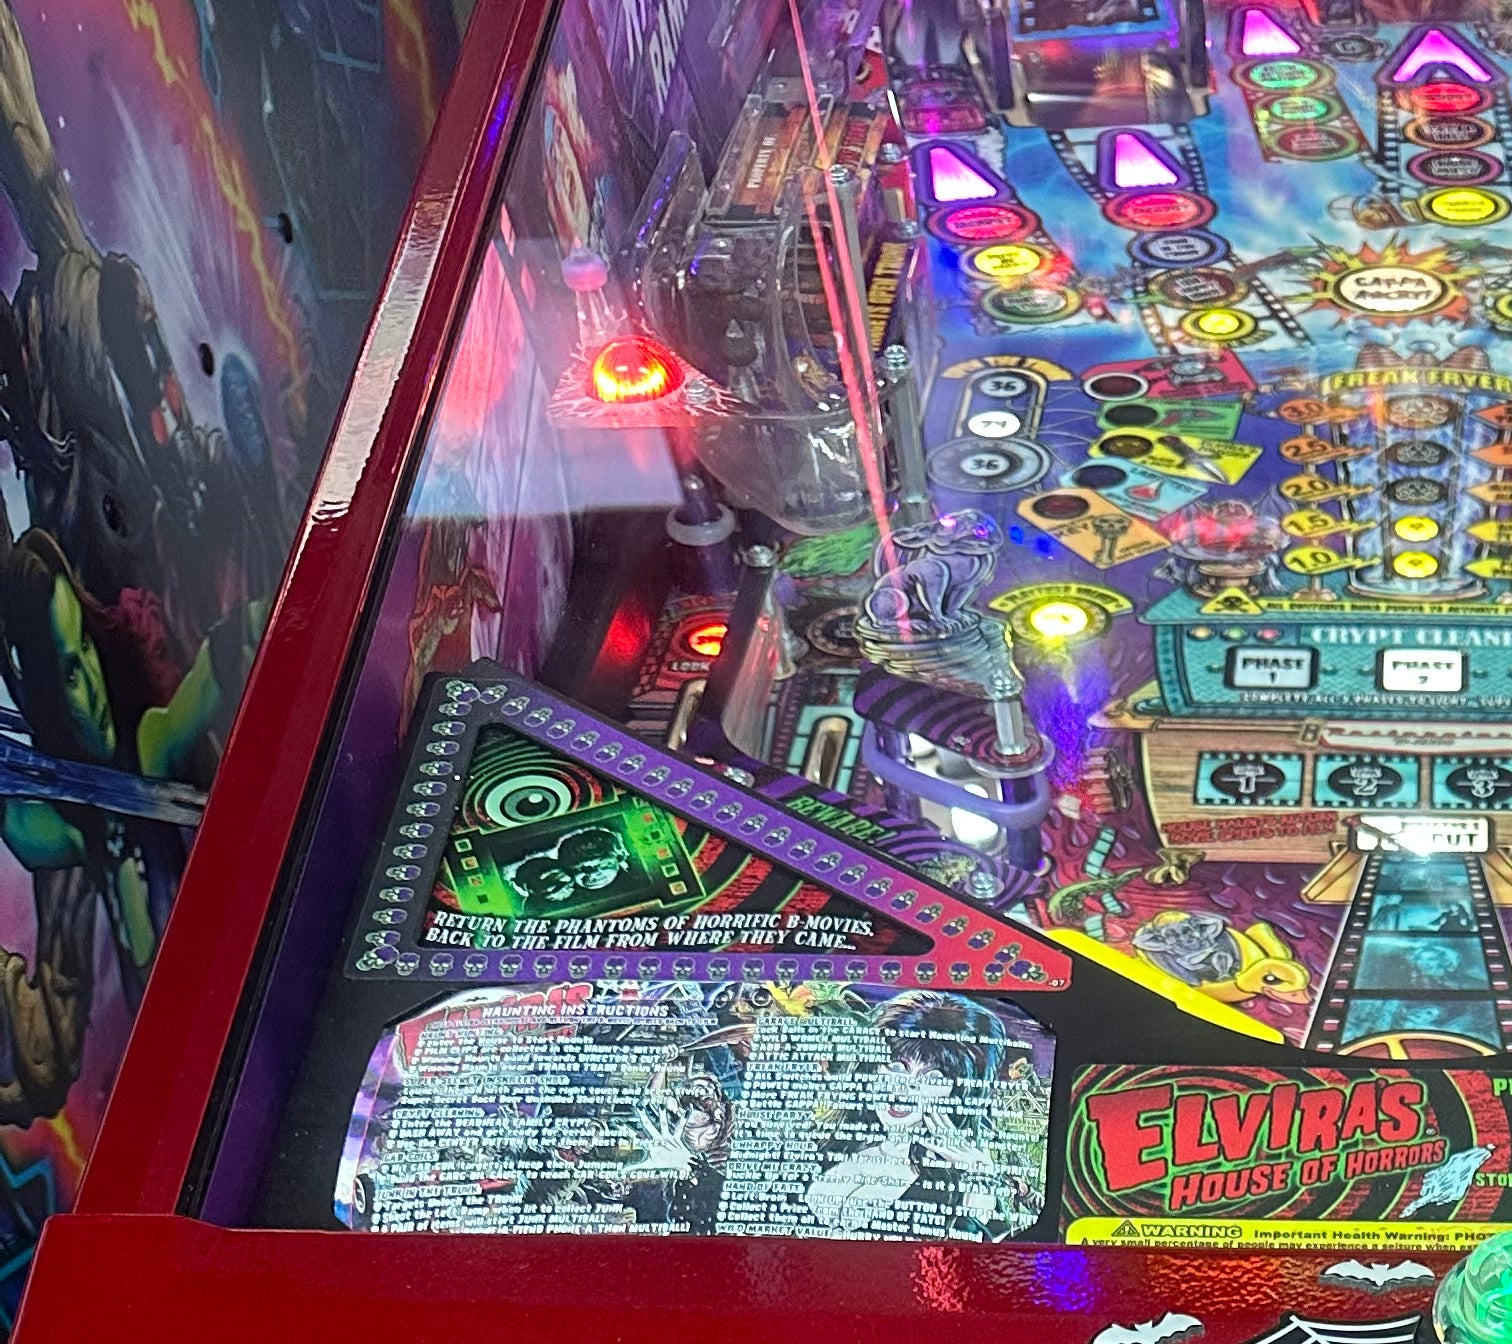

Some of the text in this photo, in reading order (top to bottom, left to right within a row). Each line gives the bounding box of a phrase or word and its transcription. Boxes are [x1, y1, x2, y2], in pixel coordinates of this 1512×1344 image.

[1331, 369, 1418, 389] FREAK
[1288, 402, 1325, 416] 3.0
[1290, 438, 1327, 454] 2.5
[1286, 480, 1329, 495] 2.0
[1290, 513, 1329, 531] 1.5
[1291, 551, 1331, 568] 1.0
[1311, 628, 1405, 644] CRYPT
[1239, 777, 1256, 793] 1
[1353, 778, 1378, 796] 2
[786, 796, 898, 844] BEWARE!
[433, 910, 875, 937] RETURN THE PHANTOMS OF HORRIFIC B-MOVIES.
[425, 928, 475, 947] BACK
[482, 935, 506, 948] TO
[512, 935, 550, 949] THE
[553, 935, 601, 949] FILM
[605, 933, 660, 949] FROM
[668, 930, 735, 946] WHERE
[739, 930, 790, 945] THEY
[482, 1004, 670, 1017] HAUNTING INSTRUCTIONS
[832, 1036, 887, 1045] MULTIBALL
[836, 1054, 892, 1063] MULTIBALL
[1086, 1078, 1424, 1191] ELVIRA'S
[1169, 1139, 1447, 1210] HOUSE OF HORRORS
[1141, 1224, 1243, 1239] WARNING
[1254, 1230, 1328, 1241] Important
[1332, 1231, 1381, 1241] Health
[1385, 1232, 1450, 1243] Warning:
